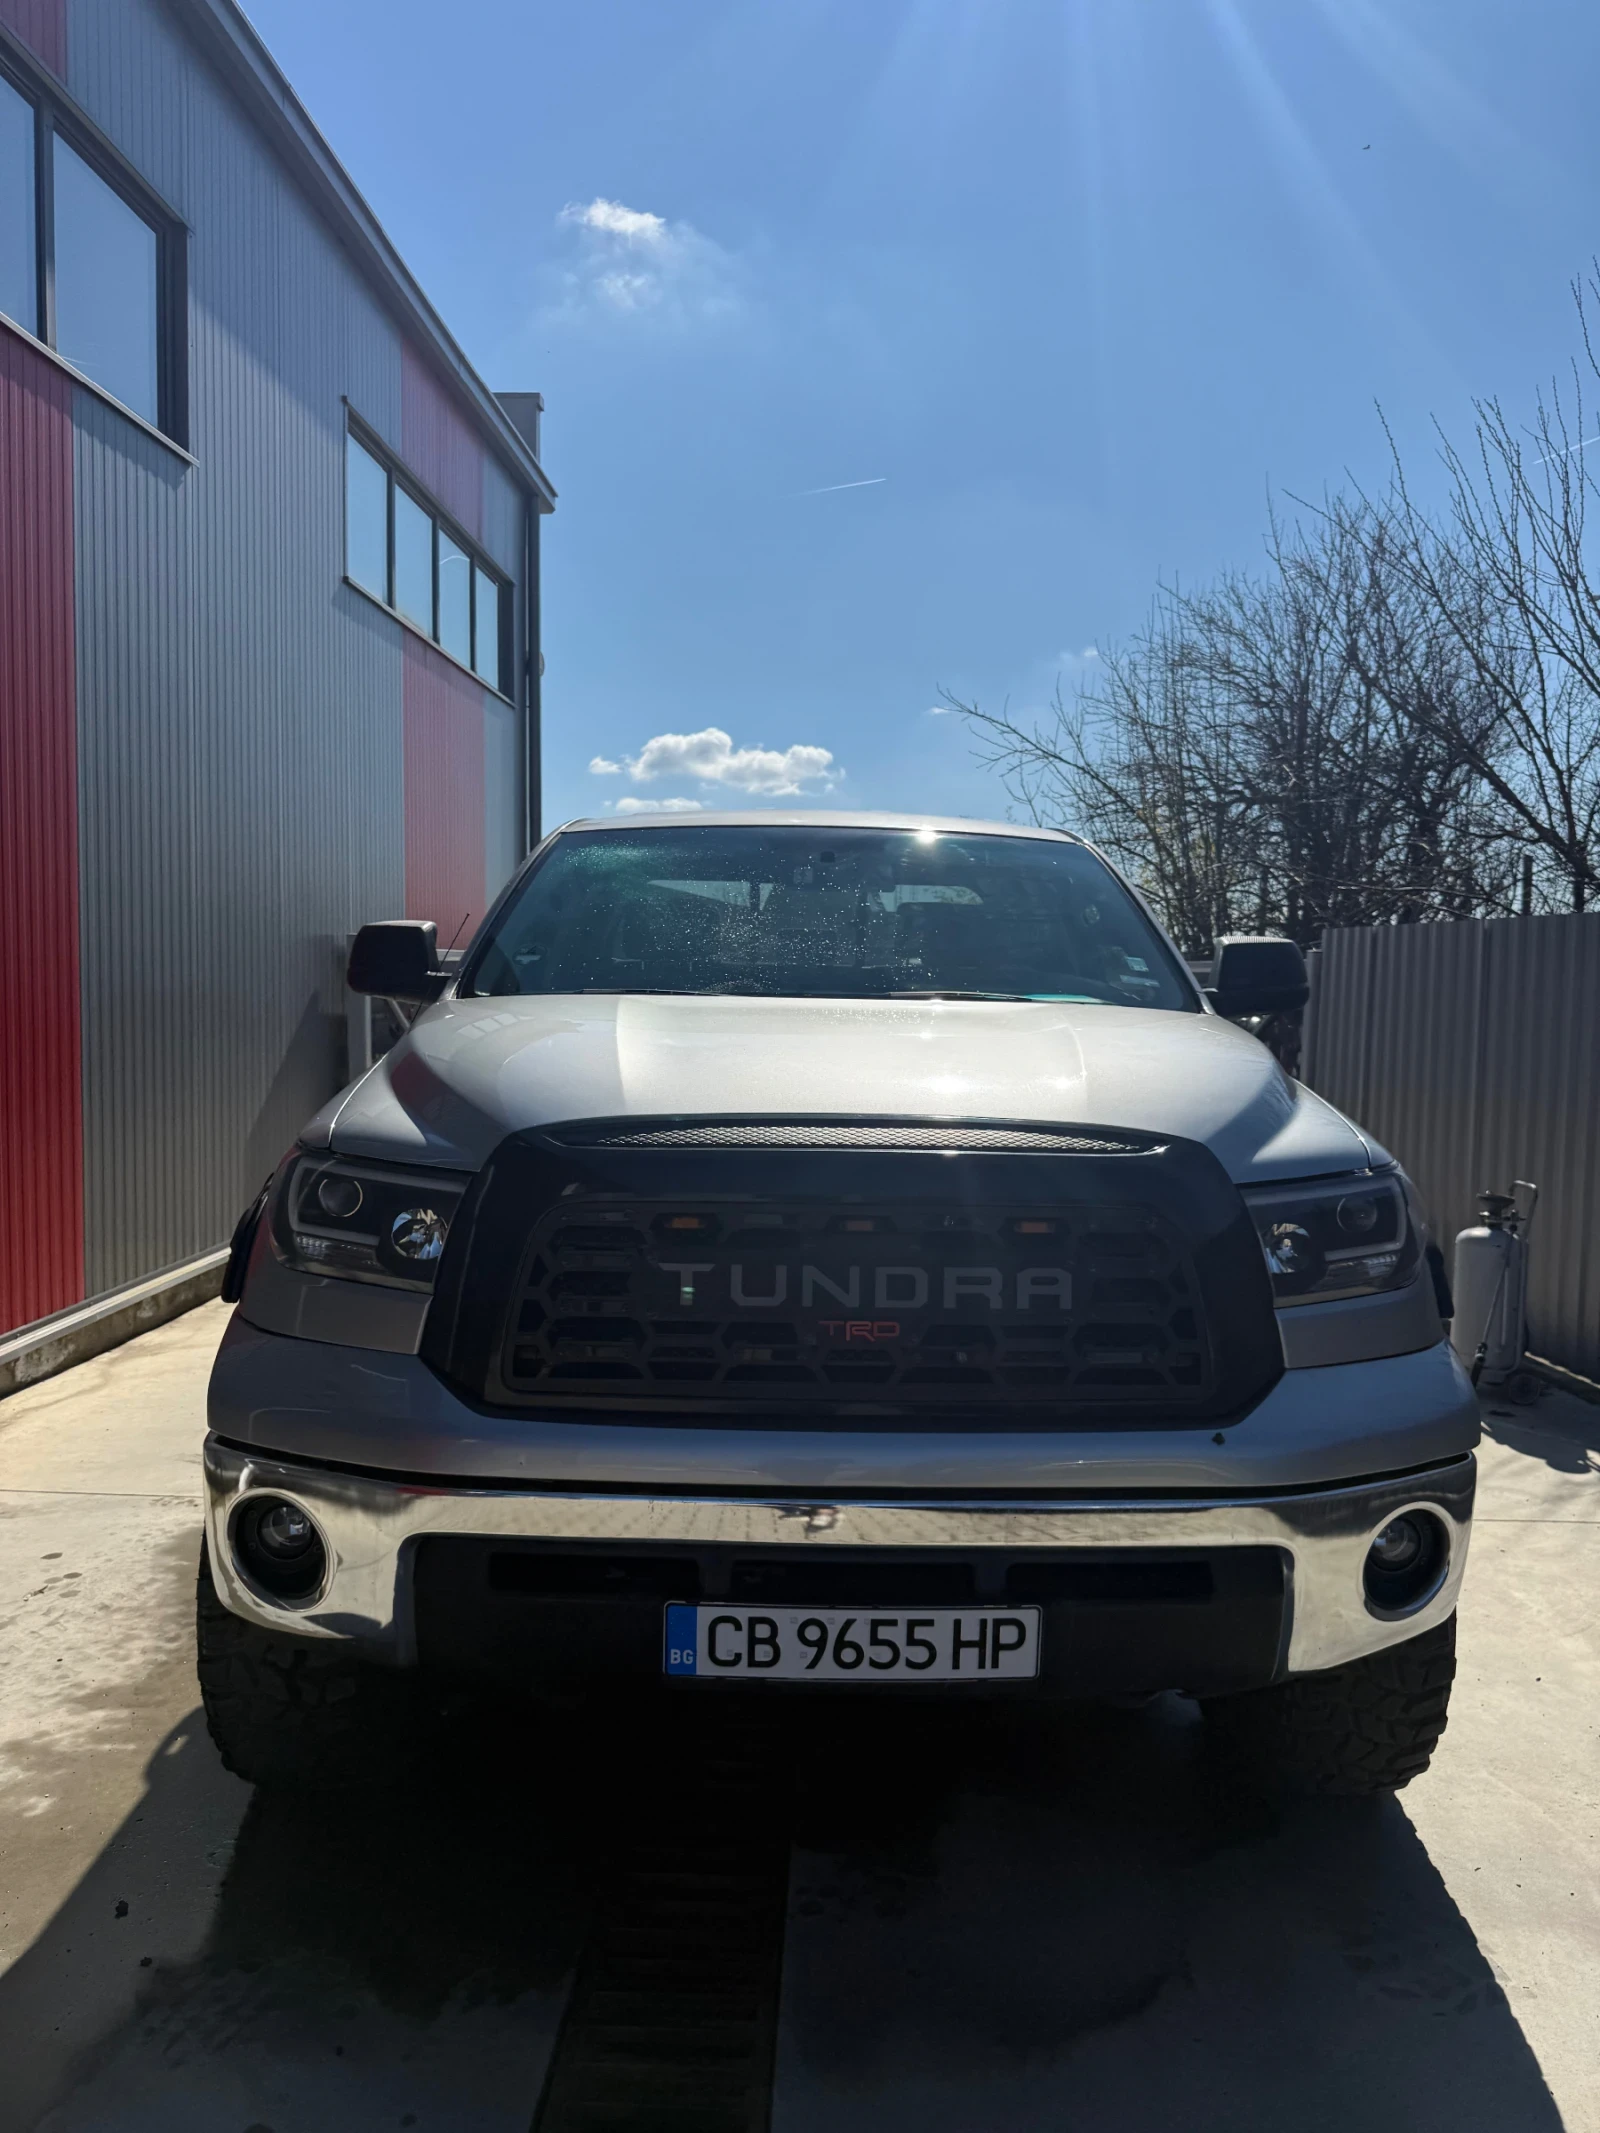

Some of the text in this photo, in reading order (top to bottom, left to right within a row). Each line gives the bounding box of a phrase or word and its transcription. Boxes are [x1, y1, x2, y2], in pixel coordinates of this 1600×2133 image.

[658, 1262, 1072, 1310] TUNDRA
[818, 1320, 900, 1342] TRD
[669, 1648, 694, 1665] BG
[707, 1615, 1026, 1670] CB 9655 HP
